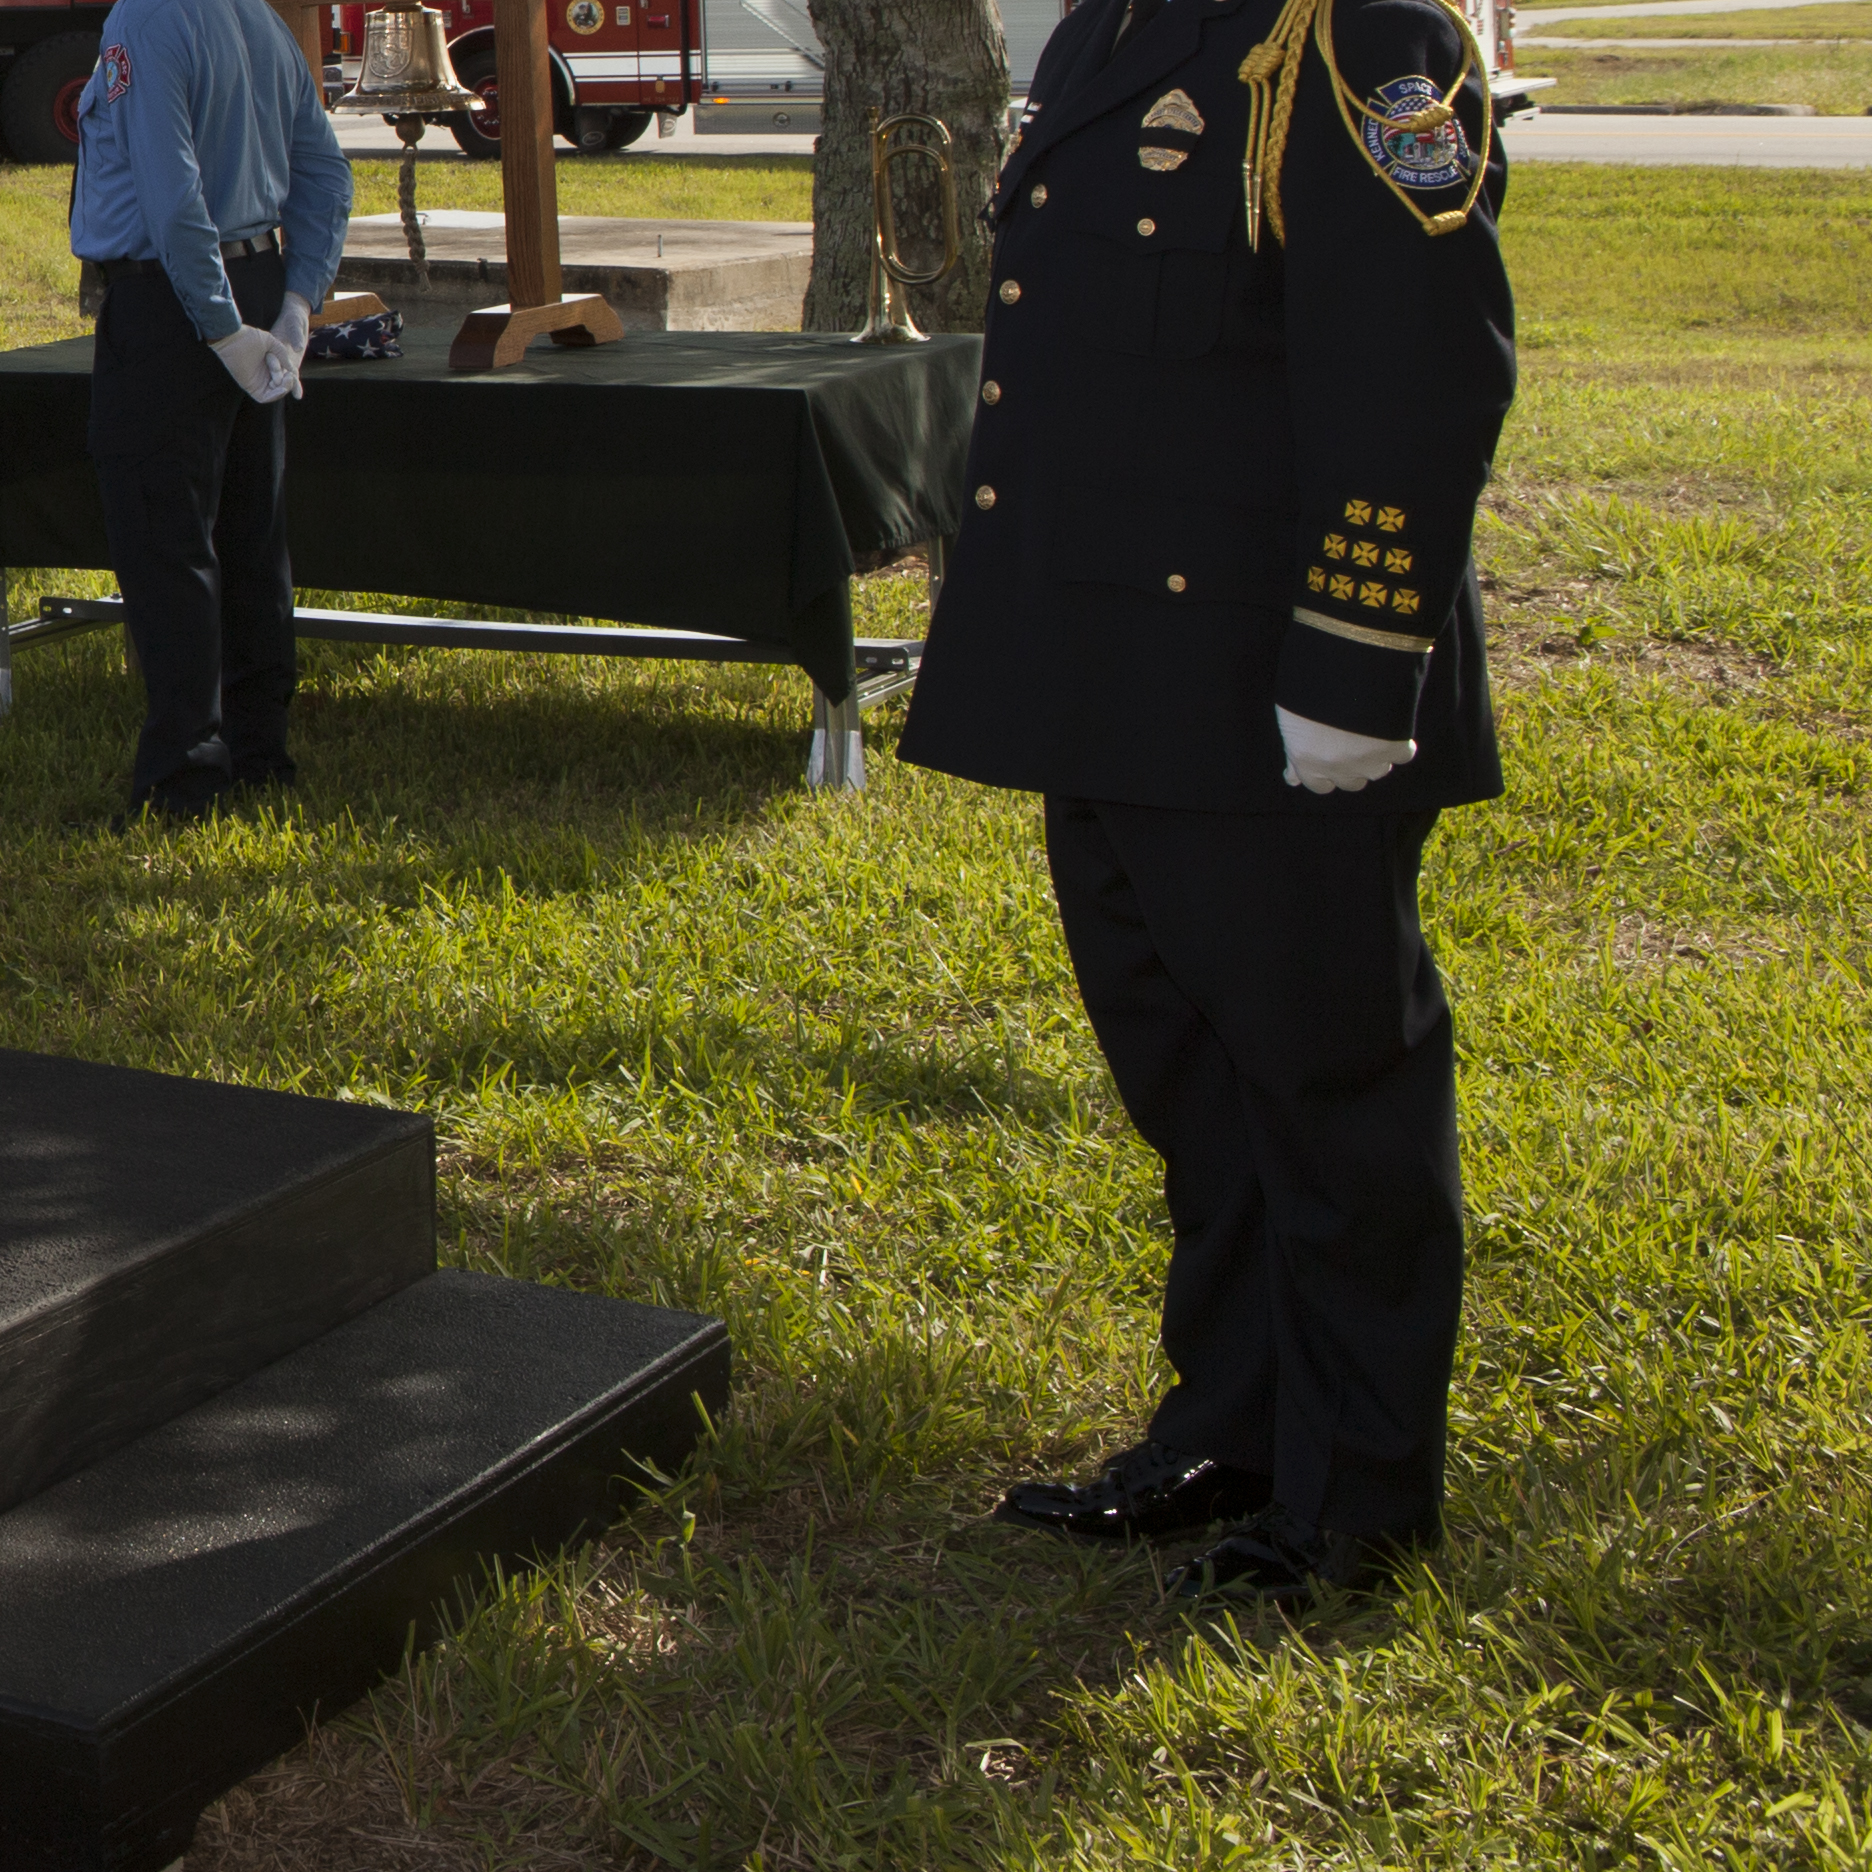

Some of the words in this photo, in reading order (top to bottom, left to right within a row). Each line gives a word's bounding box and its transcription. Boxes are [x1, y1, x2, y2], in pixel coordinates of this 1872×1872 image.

[1399, 81, 1433, 95] SPACE
[1367, 118, 1386, 162] KENNED
[1393, 167, 1418, 182] FIRE
[1419, 165, 1458, 184] RESCUE
